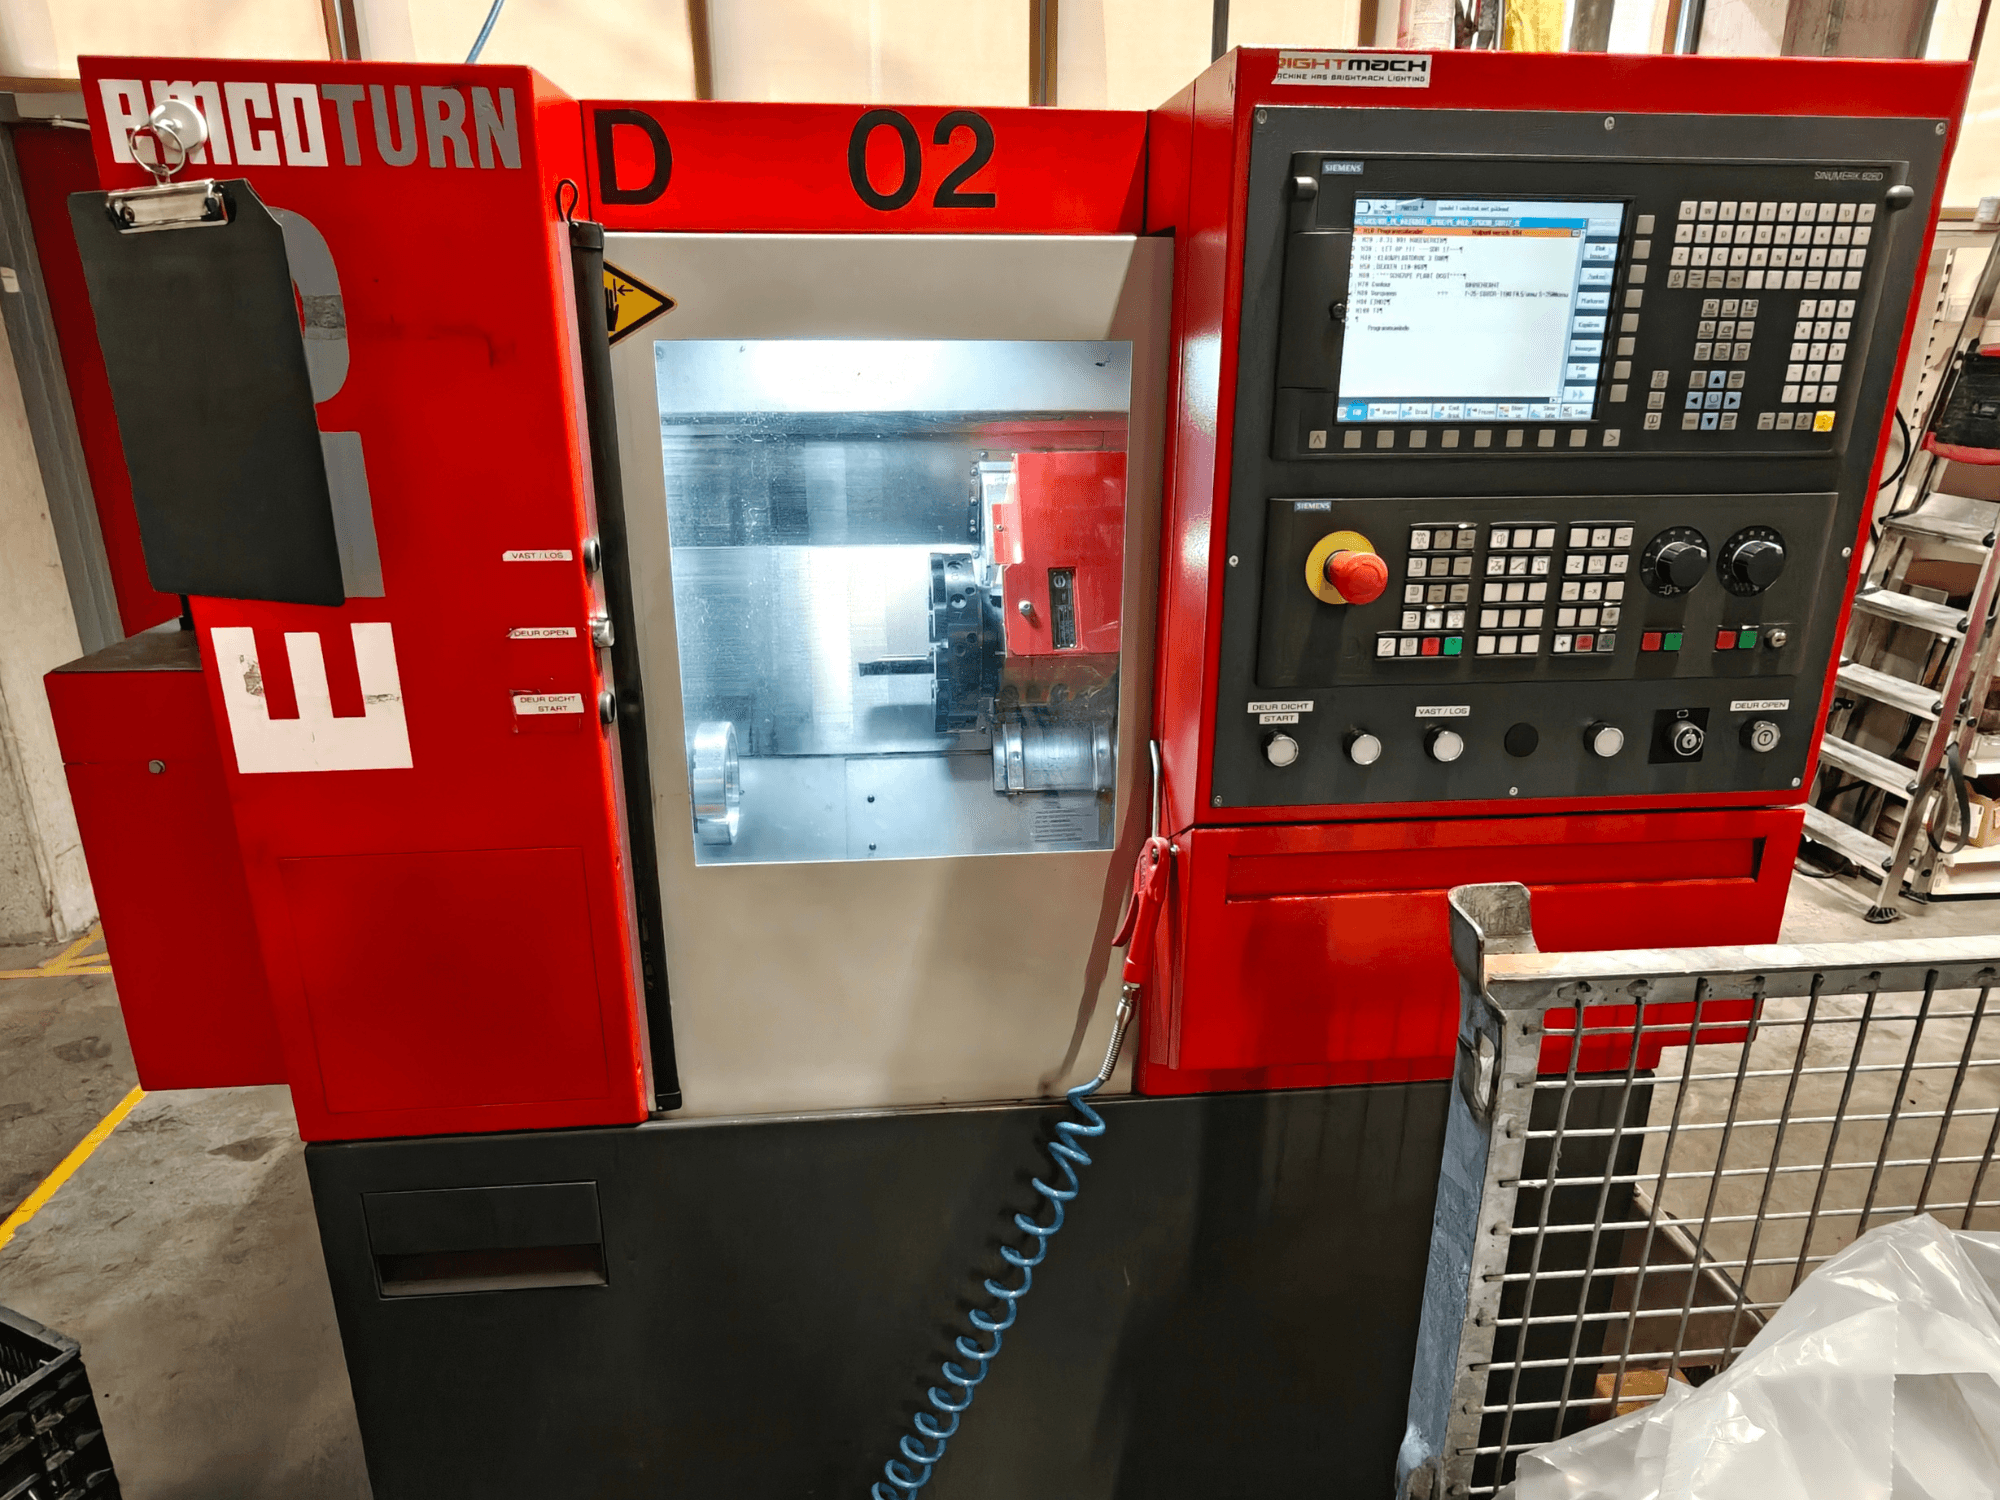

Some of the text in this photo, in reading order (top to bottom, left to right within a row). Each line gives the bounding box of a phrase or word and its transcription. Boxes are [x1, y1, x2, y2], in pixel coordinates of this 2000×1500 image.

[1331, 74, 1384, 82] BRIGHTMACH
[594, 108, 998, 211] D 02
[1324, 163, 1362, 173] SIEMENS
[1296, 502, 1330, 510] SIEMENS
[514, 629, 569, 637] DEUR OPEN
[548, 695, 575, 703] DICHT
